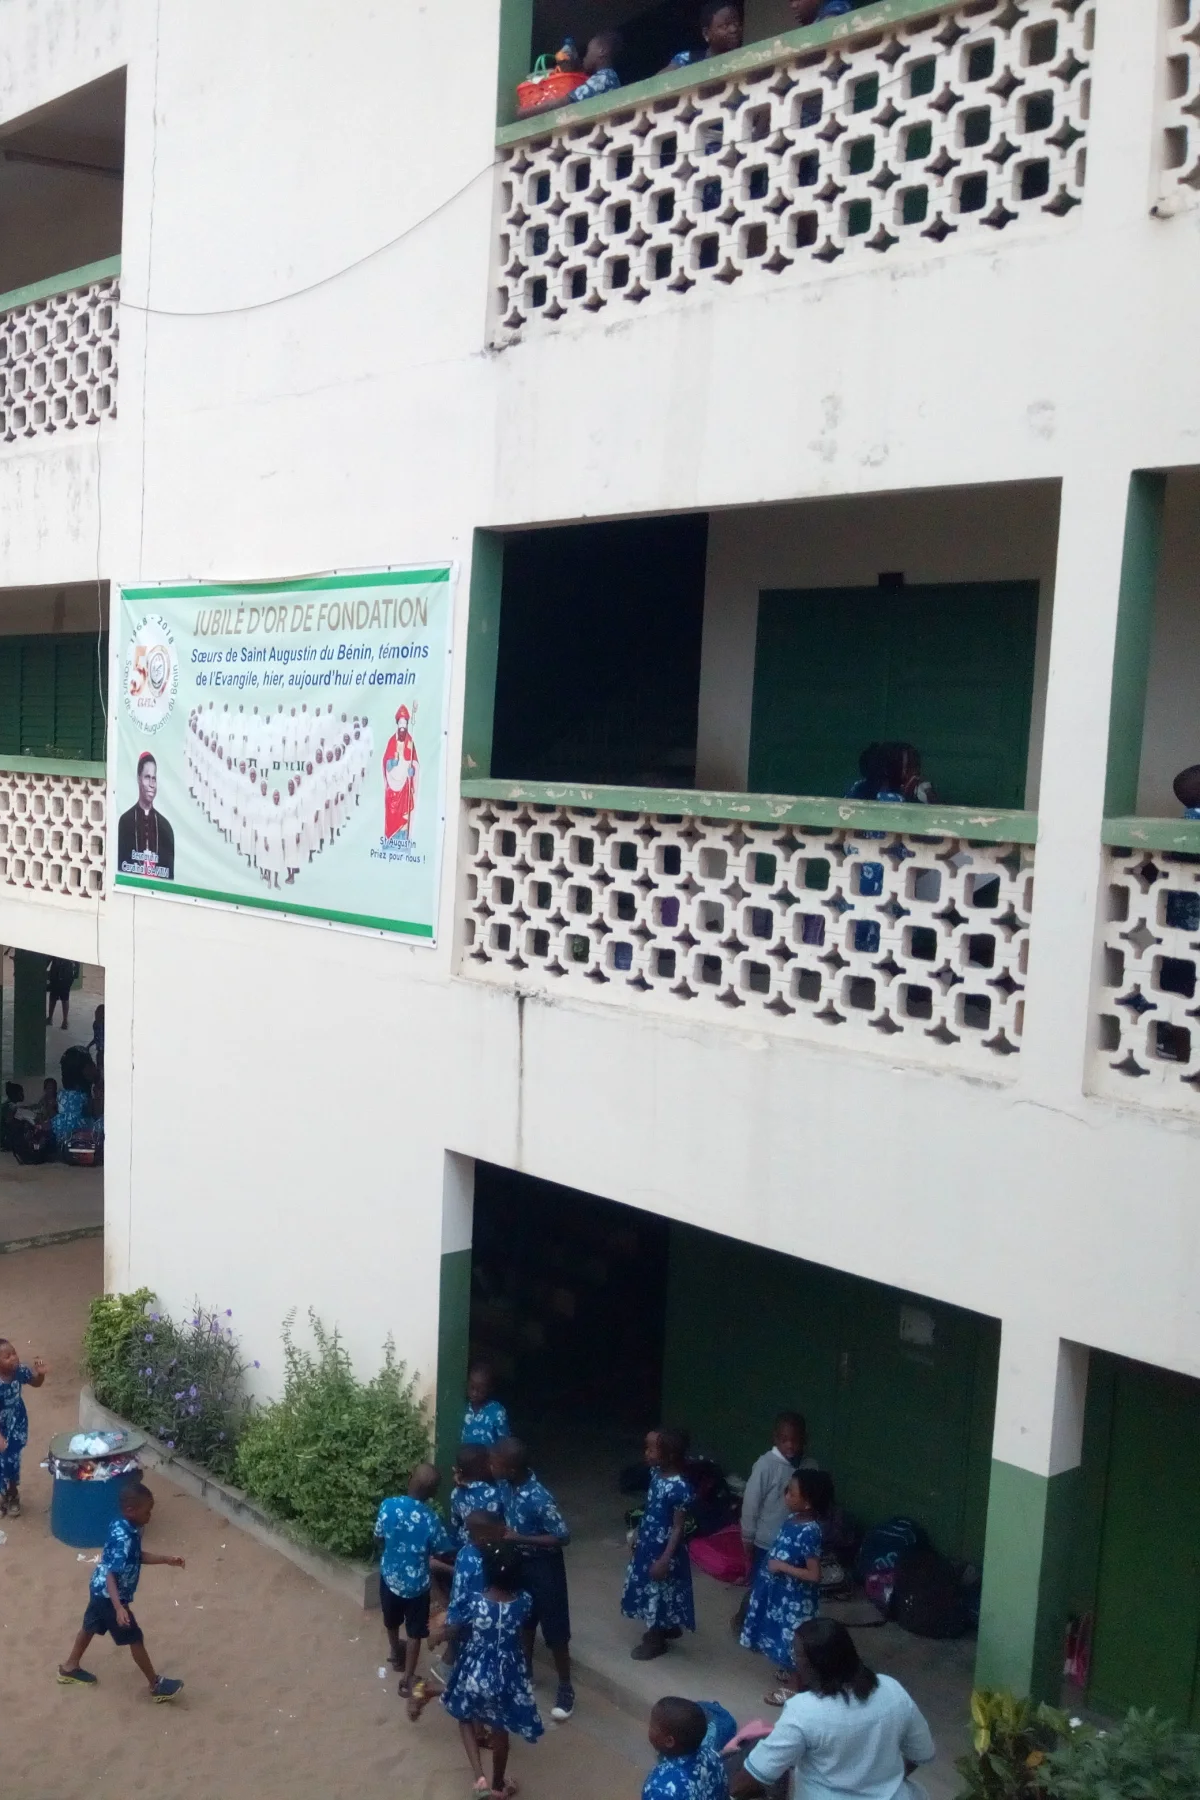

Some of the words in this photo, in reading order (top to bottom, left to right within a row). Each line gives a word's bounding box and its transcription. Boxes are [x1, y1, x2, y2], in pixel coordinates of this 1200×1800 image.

[193, 600, 245, 637] JUBILÉ
[247, 605, 288, 634] D'OR
[290, 603, 315, 633] DE
[317, 597, 428, 631] FONDATION
[157, 616, 174, 645] 2018
[191, 648, 223, 663] Sœurs
[225, 647, 238, 662] de
[240, 647, 267, 662] Saint
[269, 646, 317, 665] Augustin
[320, 645, 334, 660] du
[337, 643, 375, 663] Bénin,
[378, 642, 429, 659] témoins
[196, 671, 208, 686] de
[209, 670, 260, 690] l'Evangile,
[262, 670, 286, 688] hier,
[288, 669, 354, 690] aujourd'hui
[355, 670, 367, 685] et
[368, 669, 416, 685] demain
[128, 709, 144, 731] Saint
[144, 711, 171, 735] Augustin
[389, 837, 417, 850] Augustin
[370, 848, 387, 860] Priez
[388, 852, 404, 863] pour
[405, 854, 421, 863] nous
